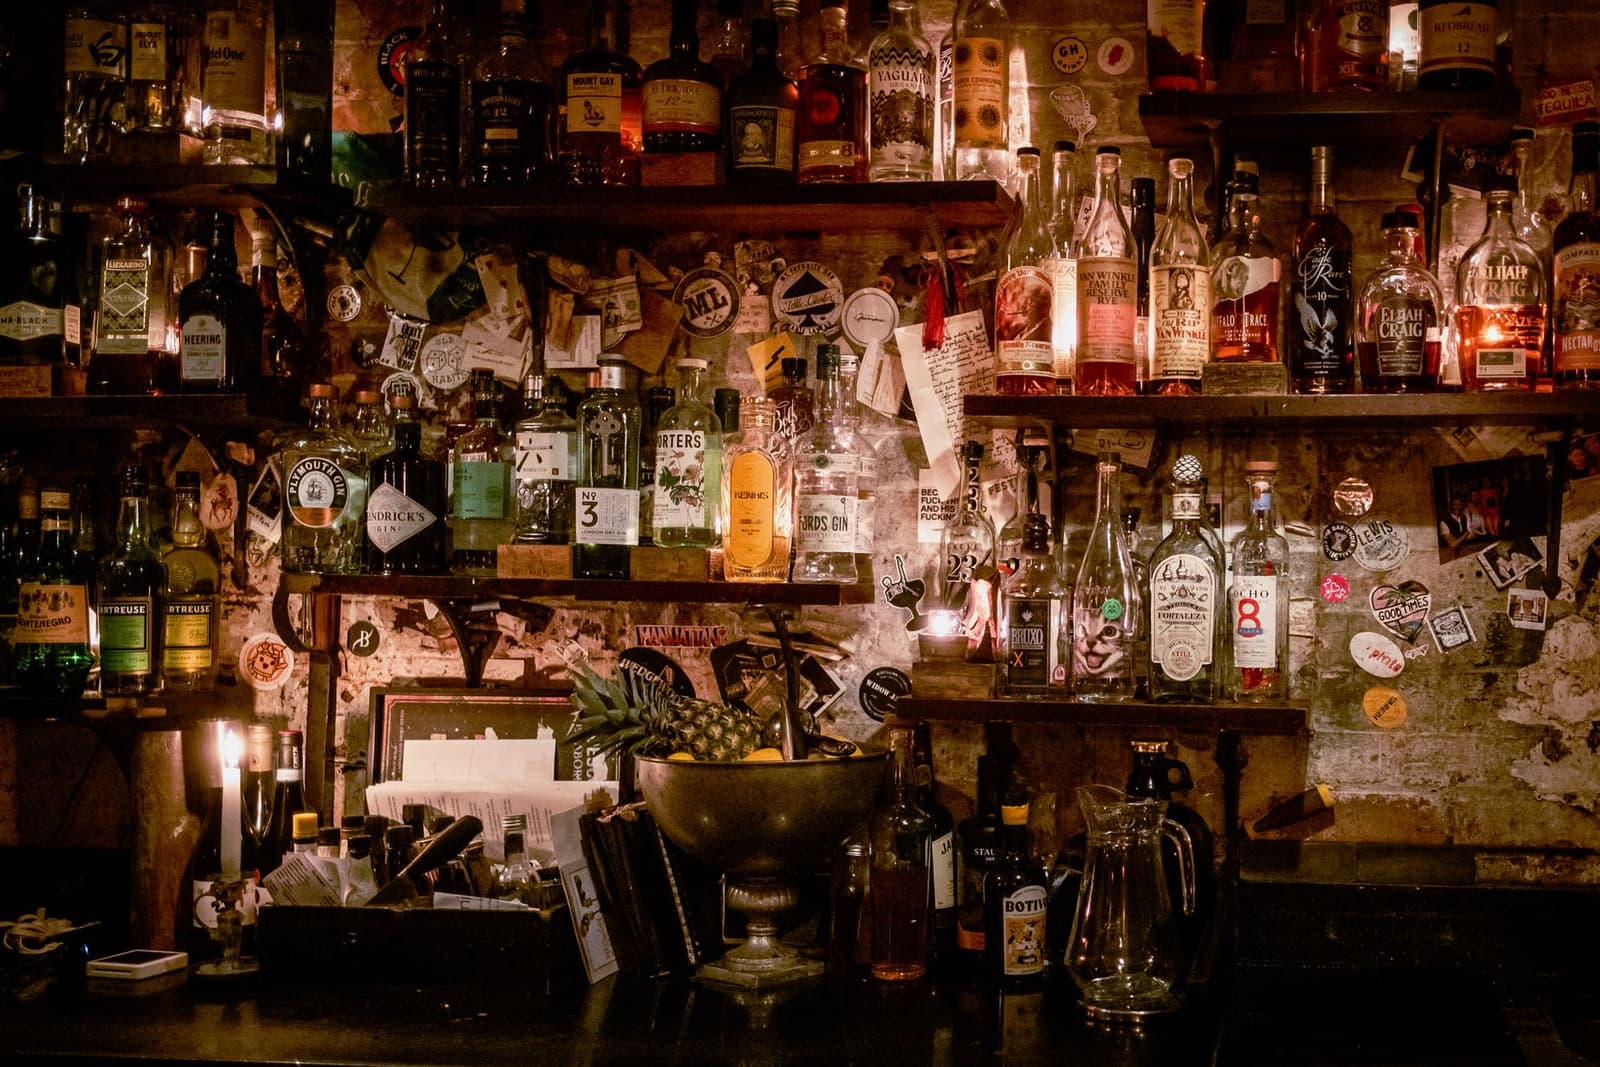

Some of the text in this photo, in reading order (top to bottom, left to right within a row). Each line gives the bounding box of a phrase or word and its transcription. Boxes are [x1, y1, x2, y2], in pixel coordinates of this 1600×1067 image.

[380, 32, 408, 65] BLACK
[1060, 43, 1080, 57] GH
[1457, 42, 1470, 54] 12
[1537, 94, 1595, 116] TEQUILA
[1086, 288, 1129, 298] RESERVE
[1089, 280, 1126, 290] FAMILY
[683, 286, 729, 321] ML
[1097, 296, 1119, 305] RYE
[1317, 291, 1328, 302] 10
[1244, 312, 1268, 328] TRACE
[1380, 307, 1423, 322] ELIJAH
[1379, 322, 1423, 339] CRAIG
[184, 334, 222, 345] HEERING
[431, 371, 468, 385] HABITS
[657, 433, 702, 449] ORTERS
[289, 460, 347, 496] PLYMOUTH GIN
[367, 510, 426, 523] ENDRICK'S
[581, 501, 599, 528] 3
[921, 504, 956, 513] AND HIS
[831, 515, 849, 532] GIN
[921, 512, 957, 522] FUCKING
[377, 525, 398, 533] GIN
[1357, 519, 1394, 546] LEWIS
[947, 554, 979, 583] 23
[1157, 611, 1207, 621] FORTALEZA
[1378, 596, 1429, 622] GOOD TIMES
[1237, 597, 1263, 638] 8
[637, 626, 719, 647] MANHATTAN
[1010, 627, 1045, 644] BRUXO
[1170, 650, 1193, 658] STILL
[619, 657, 682, 706] WEDGEWOO
[866, 679, 891, 697] WIDOW
